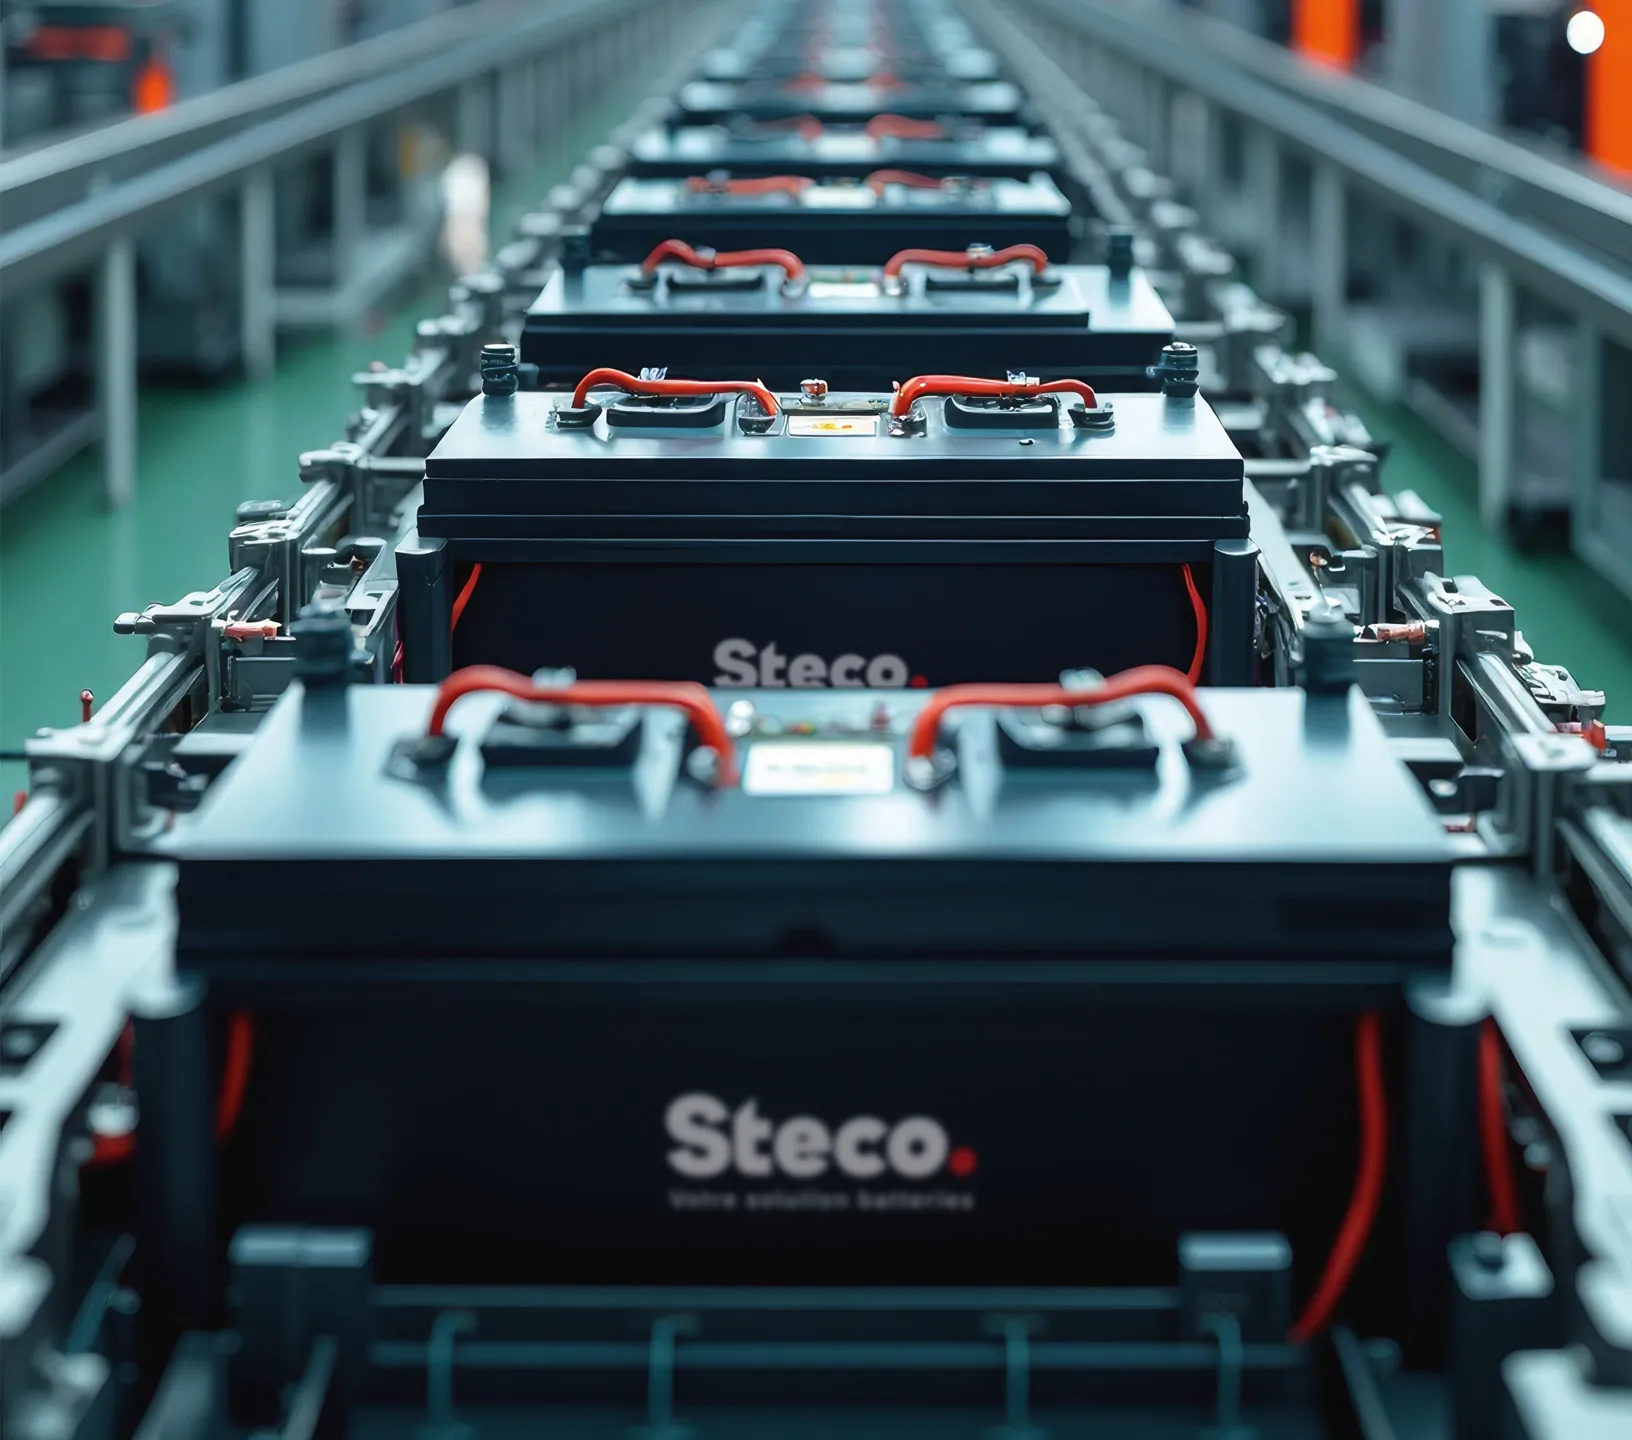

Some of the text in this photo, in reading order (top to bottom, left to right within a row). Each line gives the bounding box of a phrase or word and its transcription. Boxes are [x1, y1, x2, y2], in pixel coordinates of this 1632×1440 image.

[665, 1092, 976, 1178] Steco.
[668, 1190, 974, 1209] Votre solution batteries
